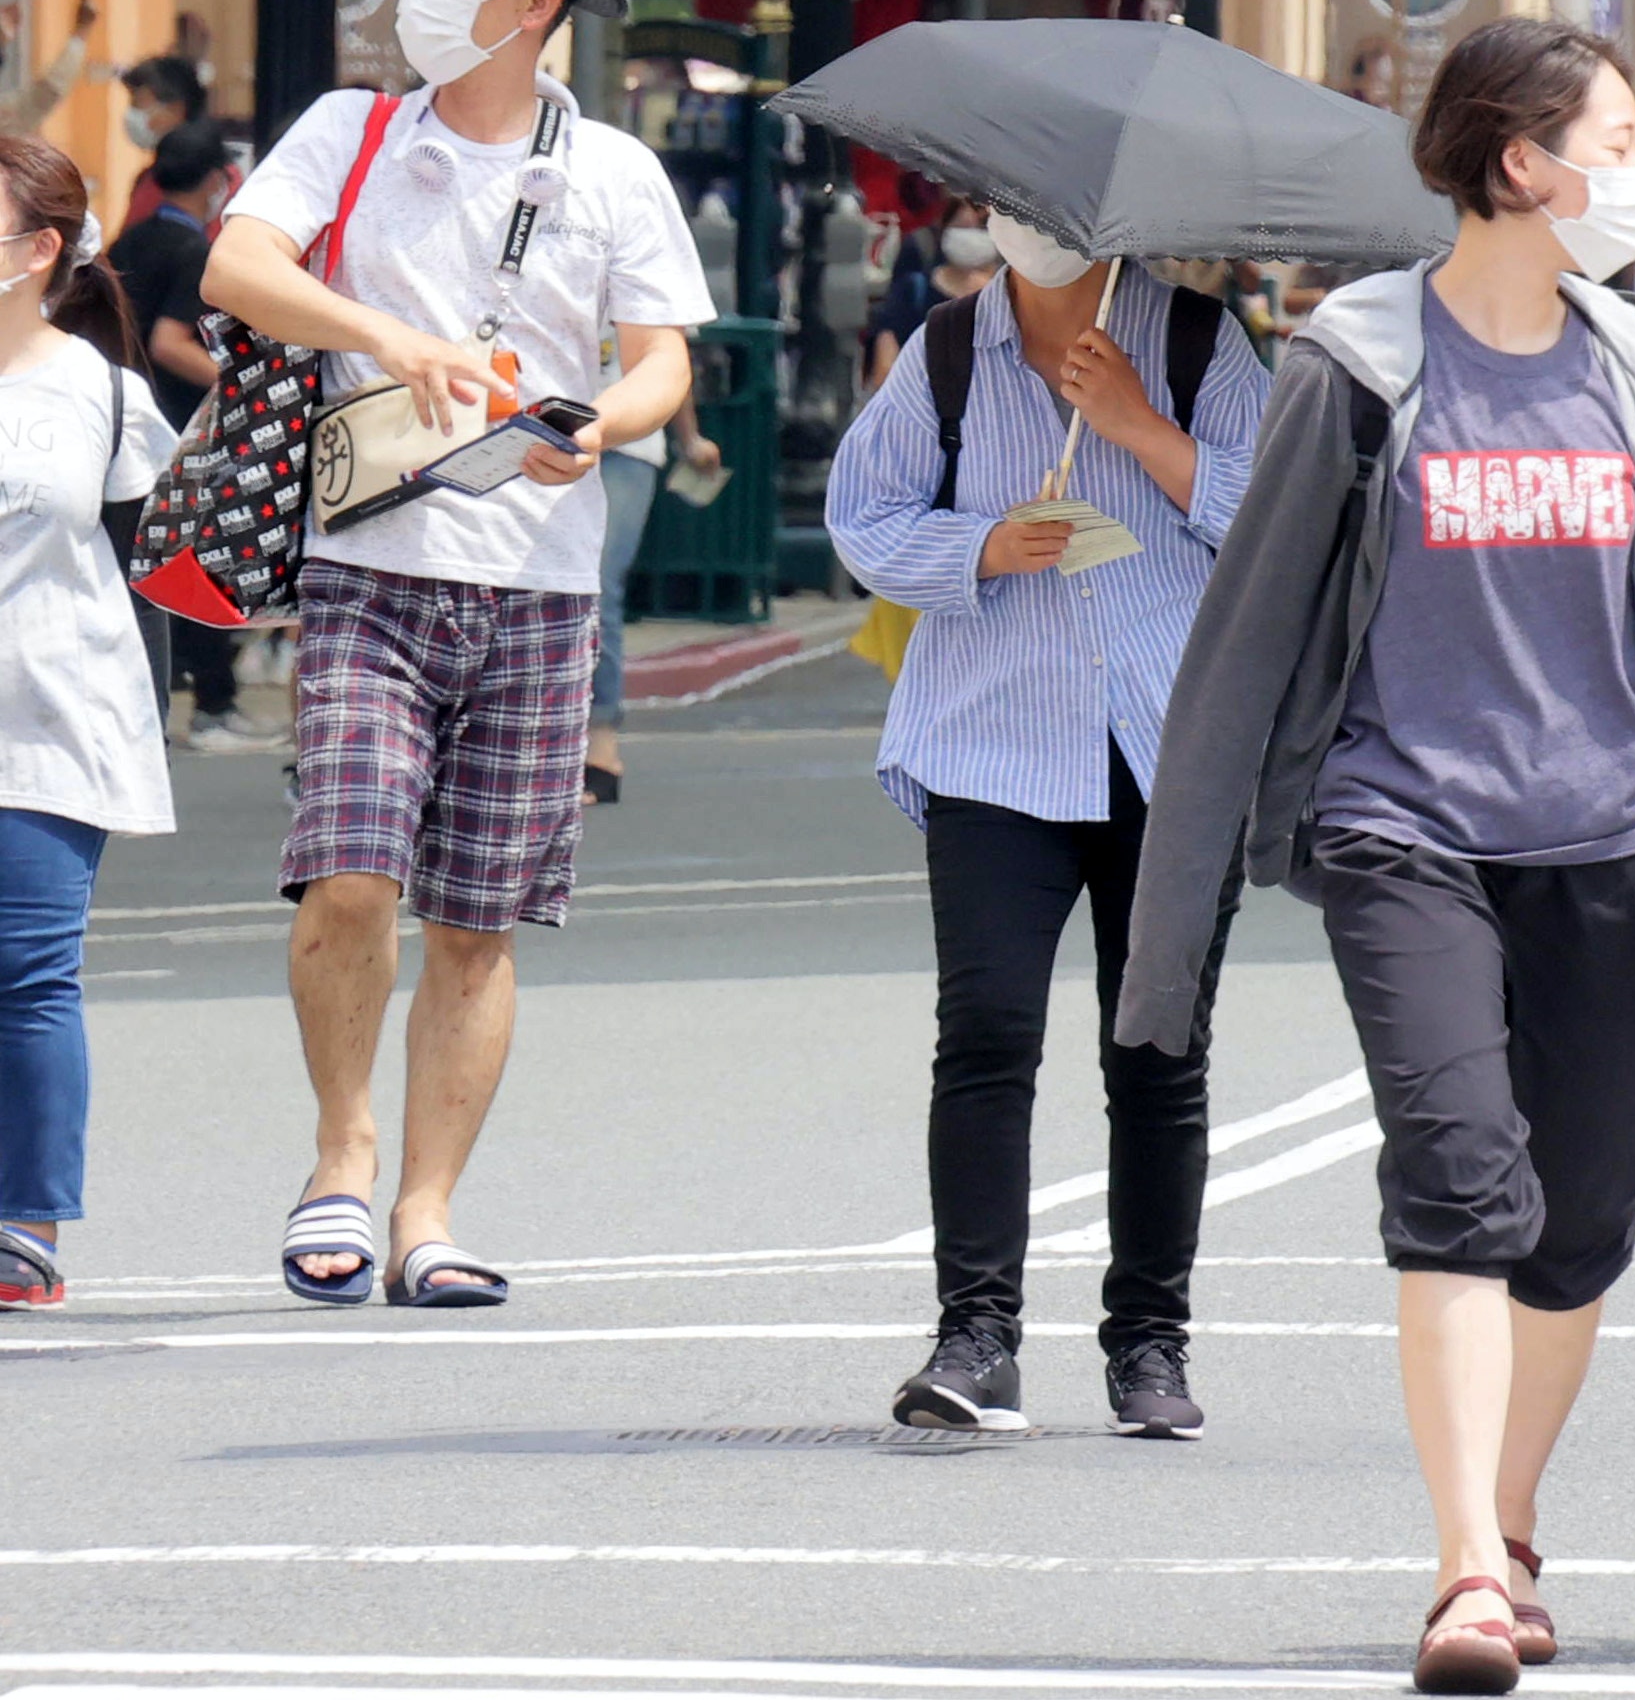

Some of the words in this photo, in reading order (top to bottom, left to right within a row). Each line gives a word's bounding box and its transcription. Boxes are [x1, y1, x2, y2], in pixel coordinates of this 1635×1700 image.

[267, 376, 298, 401] EXILE
[237, 462, 270, 486] EXILE
[1427, 455, 1630, 542] MARVEL
[217, 505, 254, 527] EXILE
[197, 546, 232, 566] EXILE
[237, 566, 271, 588] EXILE
